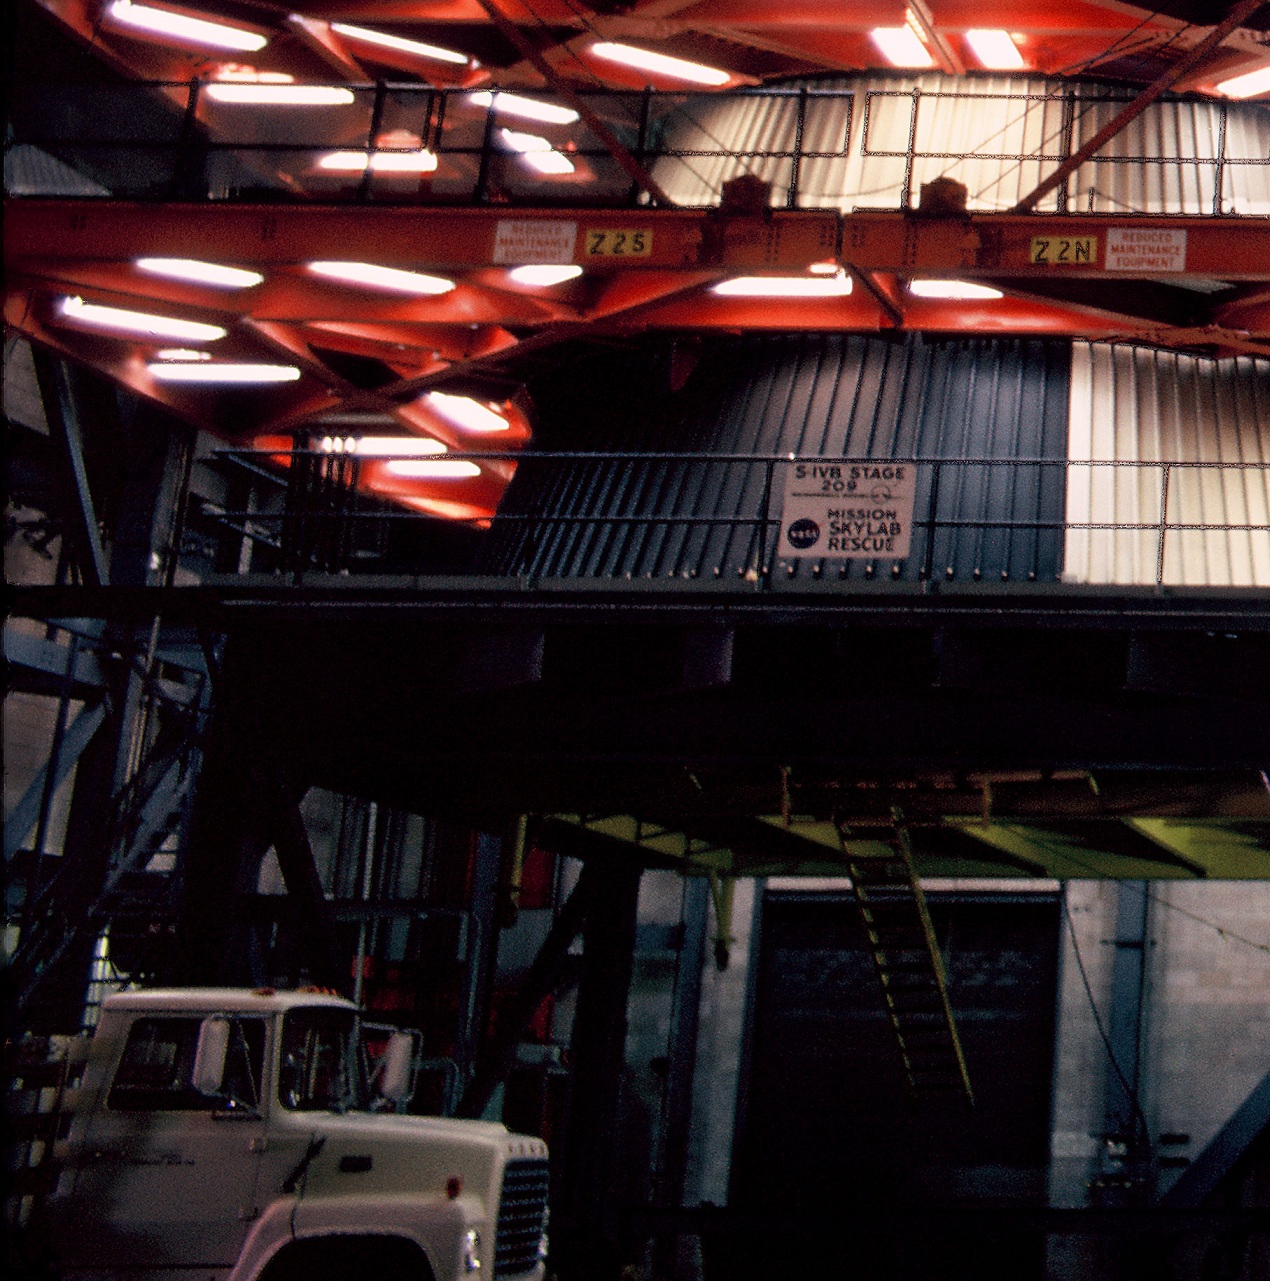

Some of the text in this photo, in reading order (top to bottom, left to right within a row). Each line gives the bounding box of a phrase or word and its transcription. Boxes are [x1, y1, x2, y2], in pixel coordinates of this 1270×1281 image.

[590, 232, 645, 255] Z2S
[1122, 232, 1173, 243] REDUCED
[1034, 240, 1091, 262] Z2N
[1111, 244, 1180, 255] MAINTENANCE
[1116, 257, 1174, 267] EQUIPMENT
[850, 466, 905, 480] STAGE
[827, 508, 897, 520] MISSION
[829, 521, 901, 537] SKYLAB
[828, 537, 895, 552] RESCUE
